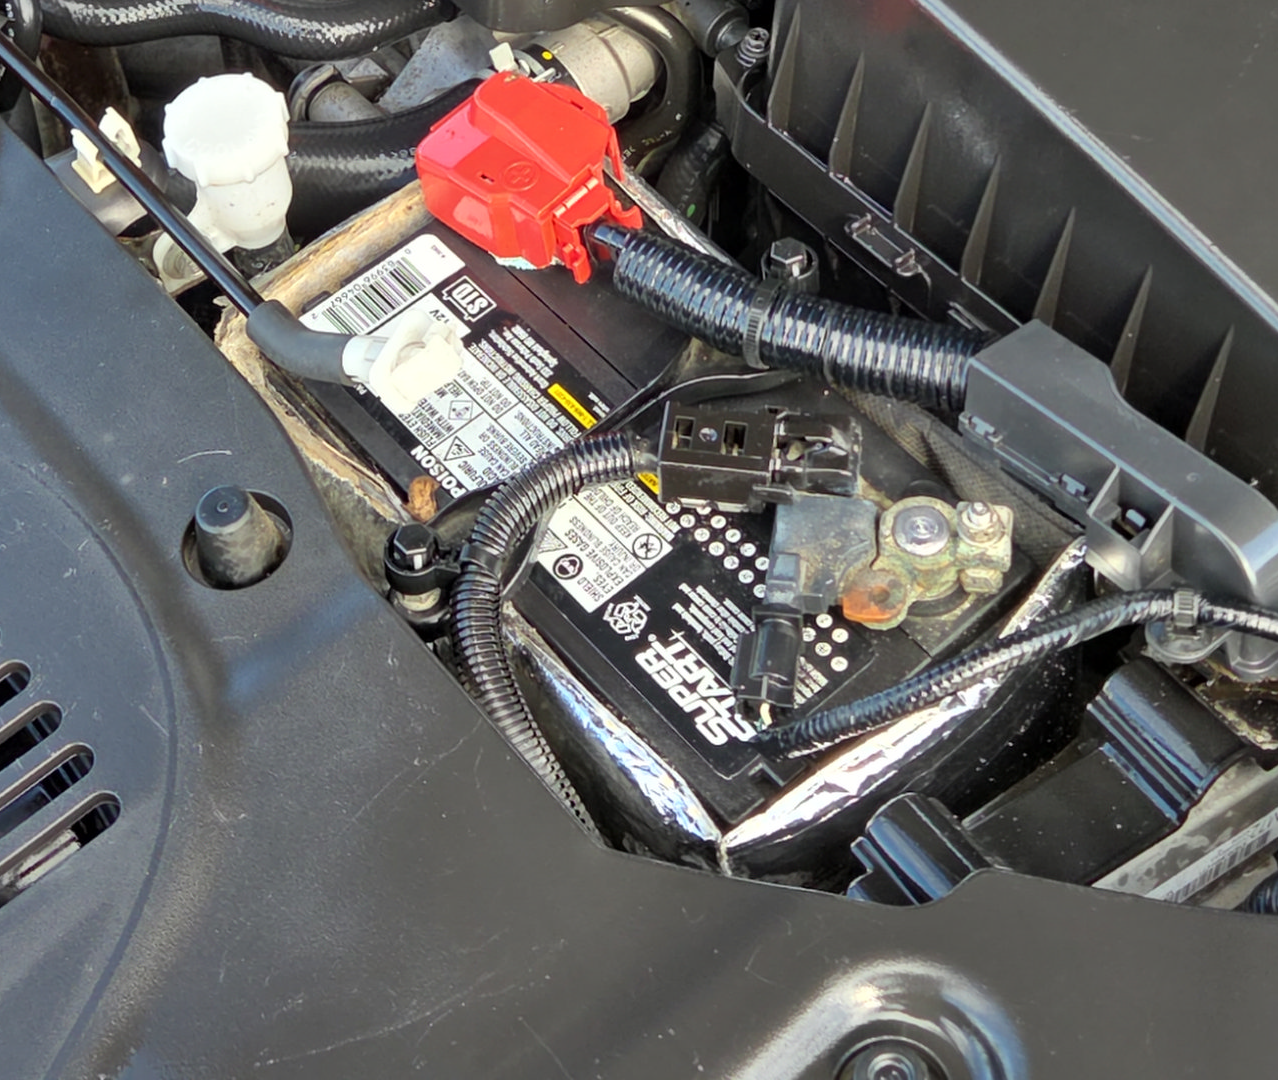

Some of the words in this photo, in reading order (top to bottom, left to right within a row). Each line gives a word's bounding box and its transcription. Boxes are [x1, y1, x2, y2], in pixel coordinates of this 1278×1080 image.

[328, 281, 363, 310] 04667
[451, 279, 490, 318] STD
[465, 377, 483, 395] OPEN
[487, 384, 504, 401] NOT
[479, 390, 495, 406] NOT
[491, 402, 503, 414] DO
[499, 395, 512, 408] DO
[409, 404, 446, 441] IMMEDIAT
[434, 413, 455, 434] WITH
[484, 422, 508, 446] BURNS.
[413, 424, 437, 448] FLUSH
[518, 428, 533, 443] ALL
[476, 445, 498, 467] CAUSE
[486, 438, 520, 472] BLINDNESS
[503, 440, 528, 465] SEVERE
[408, 441, 468, 500] POISON
[457, 458, 489, 490] ULFURIC
[494, 462, 510, 478] CAN
[582, 491, 598, 507] THE
[593, 501, 606, 514] OF
[609, 502, 622, 516] OF
[601, 509, 618, 526] OUT
[617, 510, 641, 533] REACH
[563, 526, 590, 552] GASES
[568, 514, 602, 549] BLINDNESS
[613, 520, 633, 540] KEEP
[598, 544, 621, 567] CAUSE
[606, 538, 631, 562] INJURY.
[584, 546, 624, 587] EXPLOSIVE
[616, 561, 633, 579] CAN
[626, 557, 641, 572] OR
[575, 574, 604, 603] SHIELD
[590, 571, 614, 595] EYES.
[634, 644, 731, 747] SUPER
